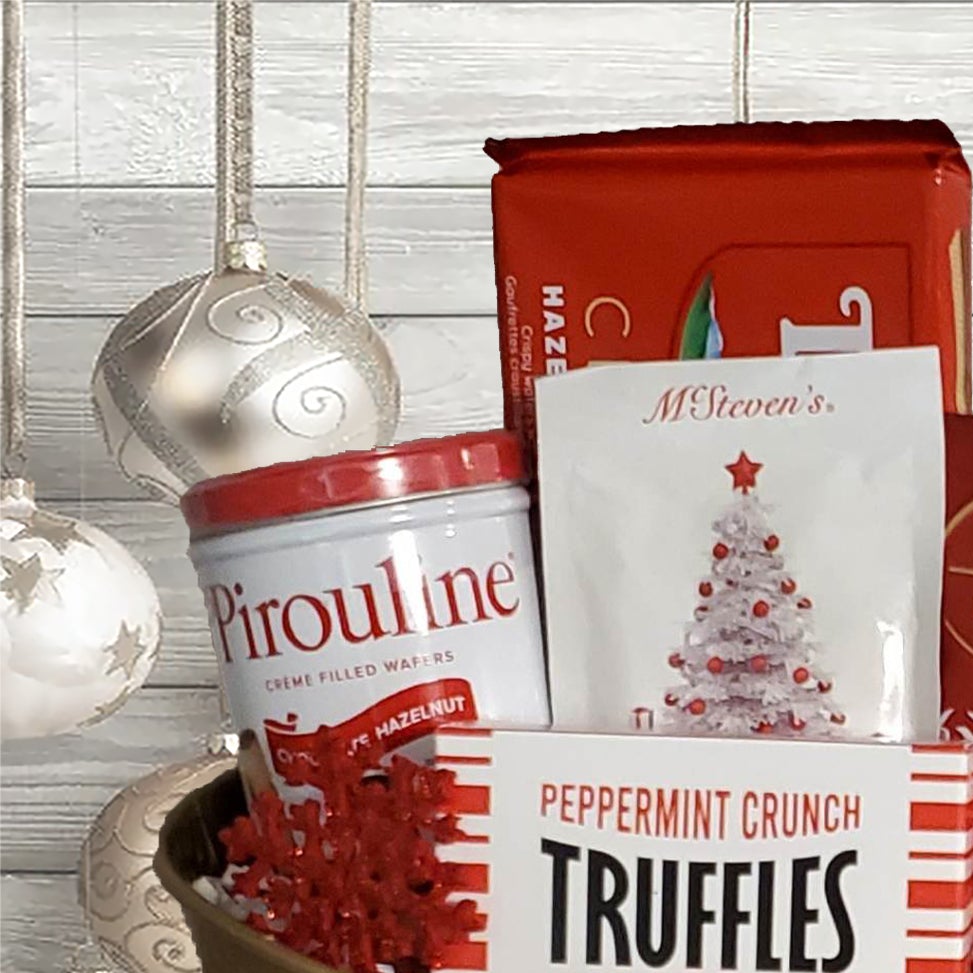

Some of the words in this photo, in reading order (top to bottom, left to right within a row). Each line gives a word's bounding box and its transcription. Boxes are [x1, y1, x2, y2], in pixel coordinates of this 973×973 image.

[542, 285, 568, 376] HAZE
[207, 555, 521, 663] Pirouline
[319, 664, 378, 684] FILLED
[383, 650, 455, 674] WAFERS
[374, 695, 466, 740] HAZELNUT
[540, 783, 731, 840] PEPPERMINT
[742, 791, 861, 840] CRUNCH
